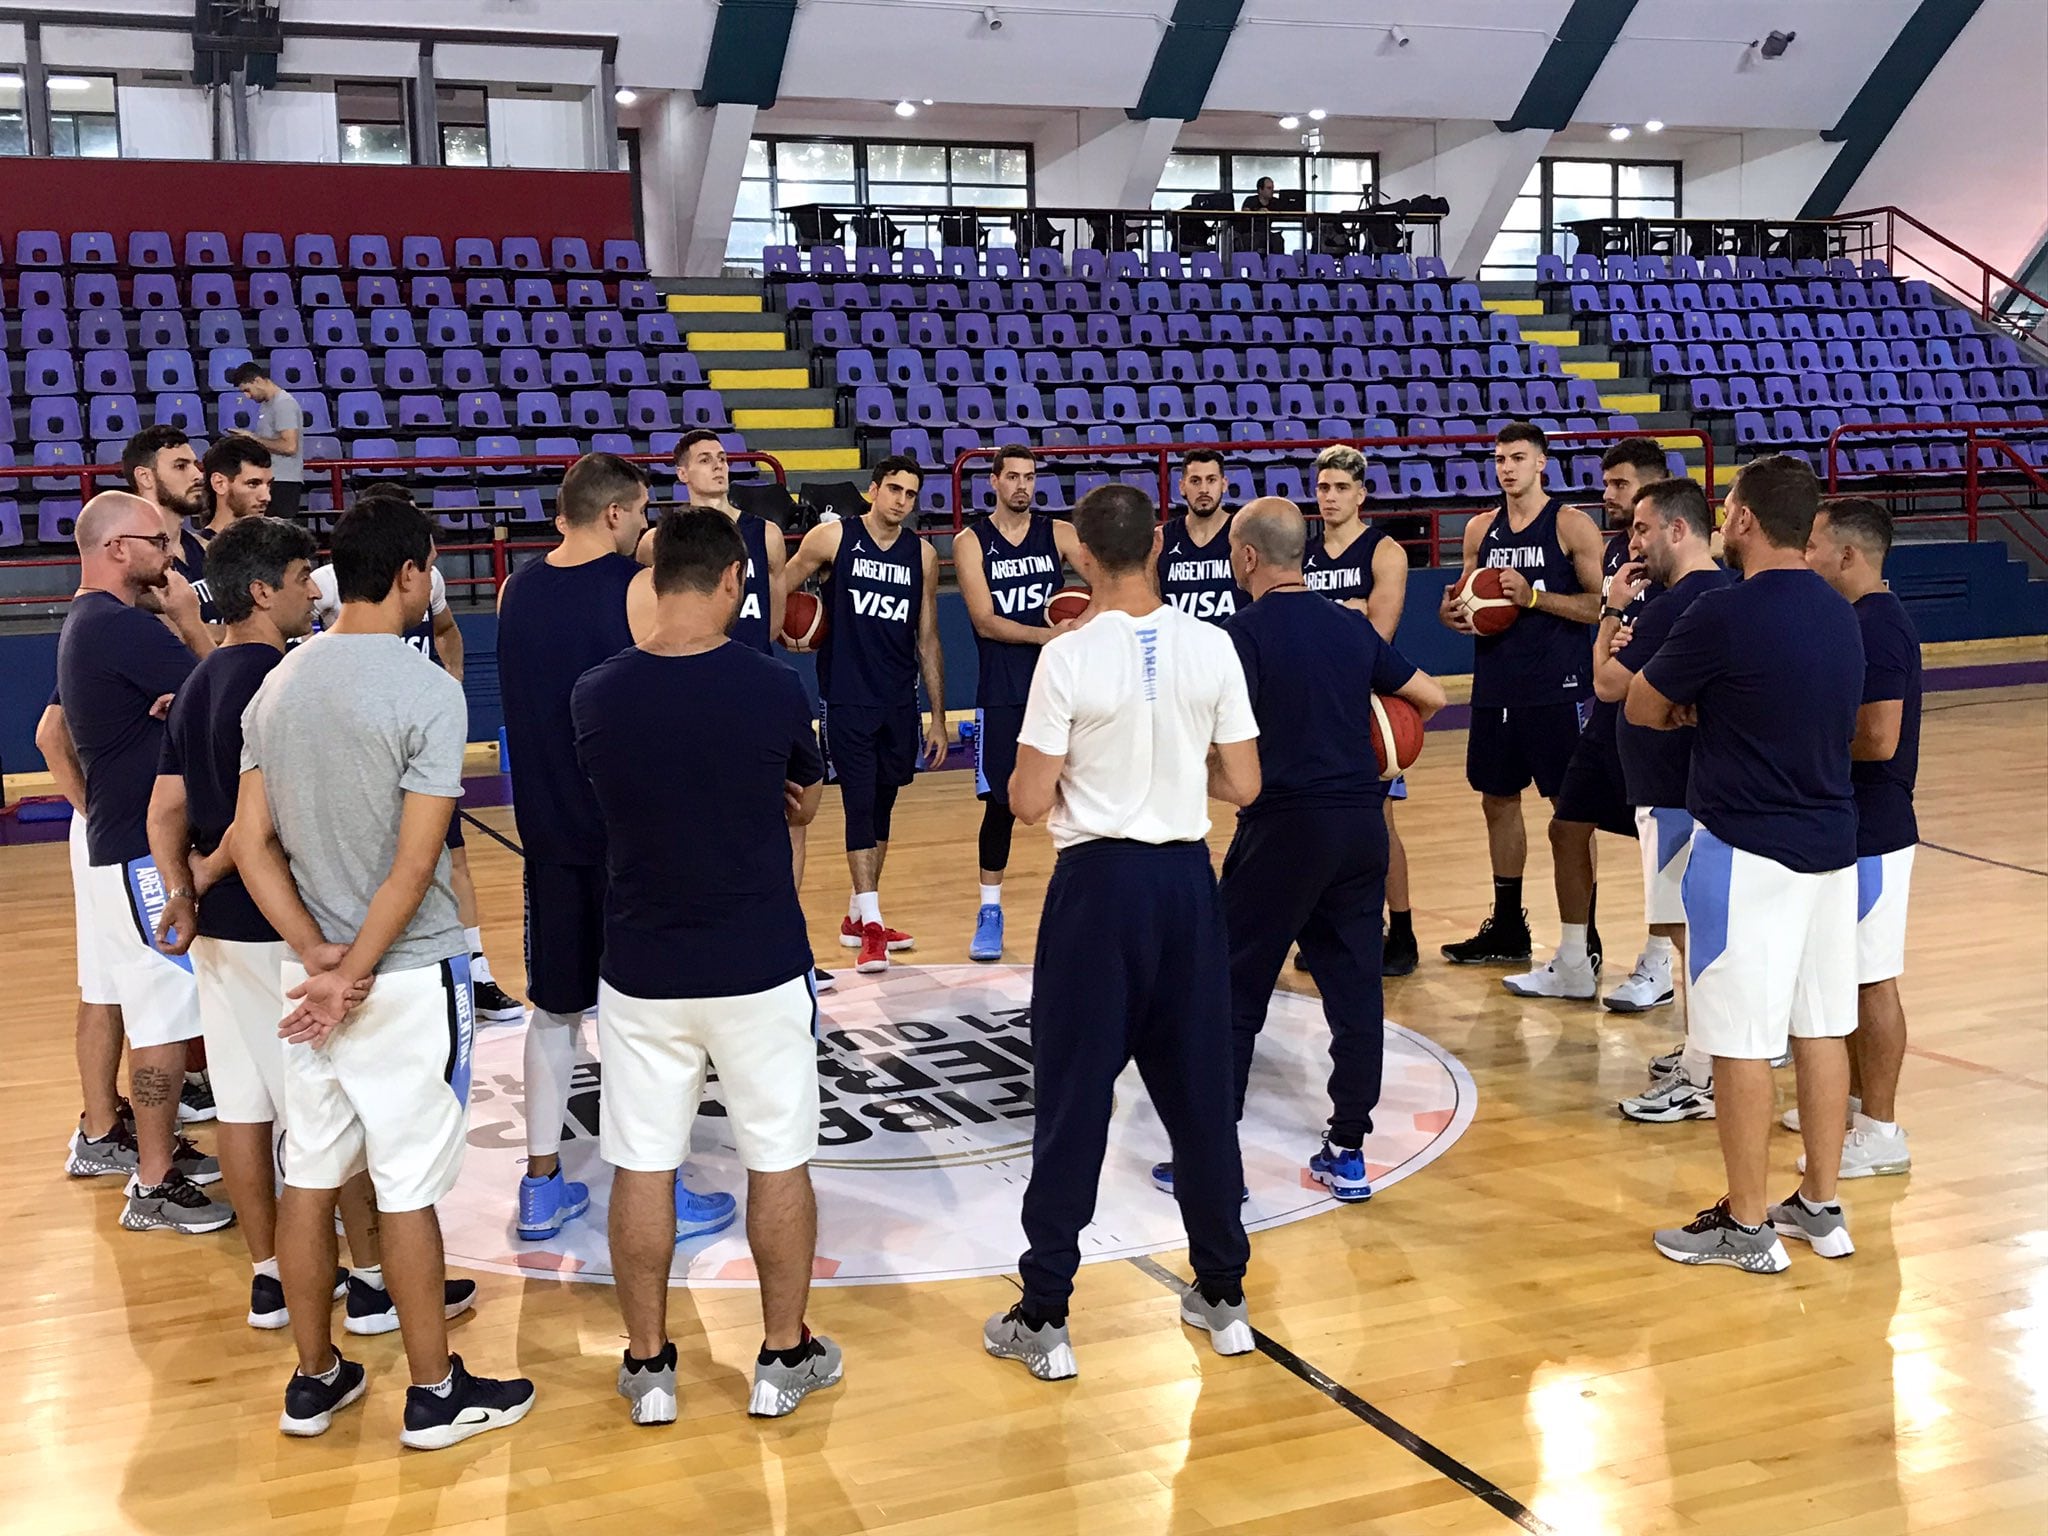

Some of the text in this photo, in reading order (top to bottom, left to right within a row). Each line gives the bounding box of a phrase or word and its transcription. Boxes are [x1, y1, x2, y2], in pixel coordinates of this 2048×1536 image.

[851, 557, 912, 587] ARGENTINA
[992, 554, 1055, 580] ARGENTINA
[1167, 559, 1232, 582] ARGENTINA
[1486, 546, 1545, 568] RGENTINA
[848, 588, 910, 624] VISA
[135, 866, 168, 935] ARGENTIN
[455, 982, 472, 1071] ARGENTINA
